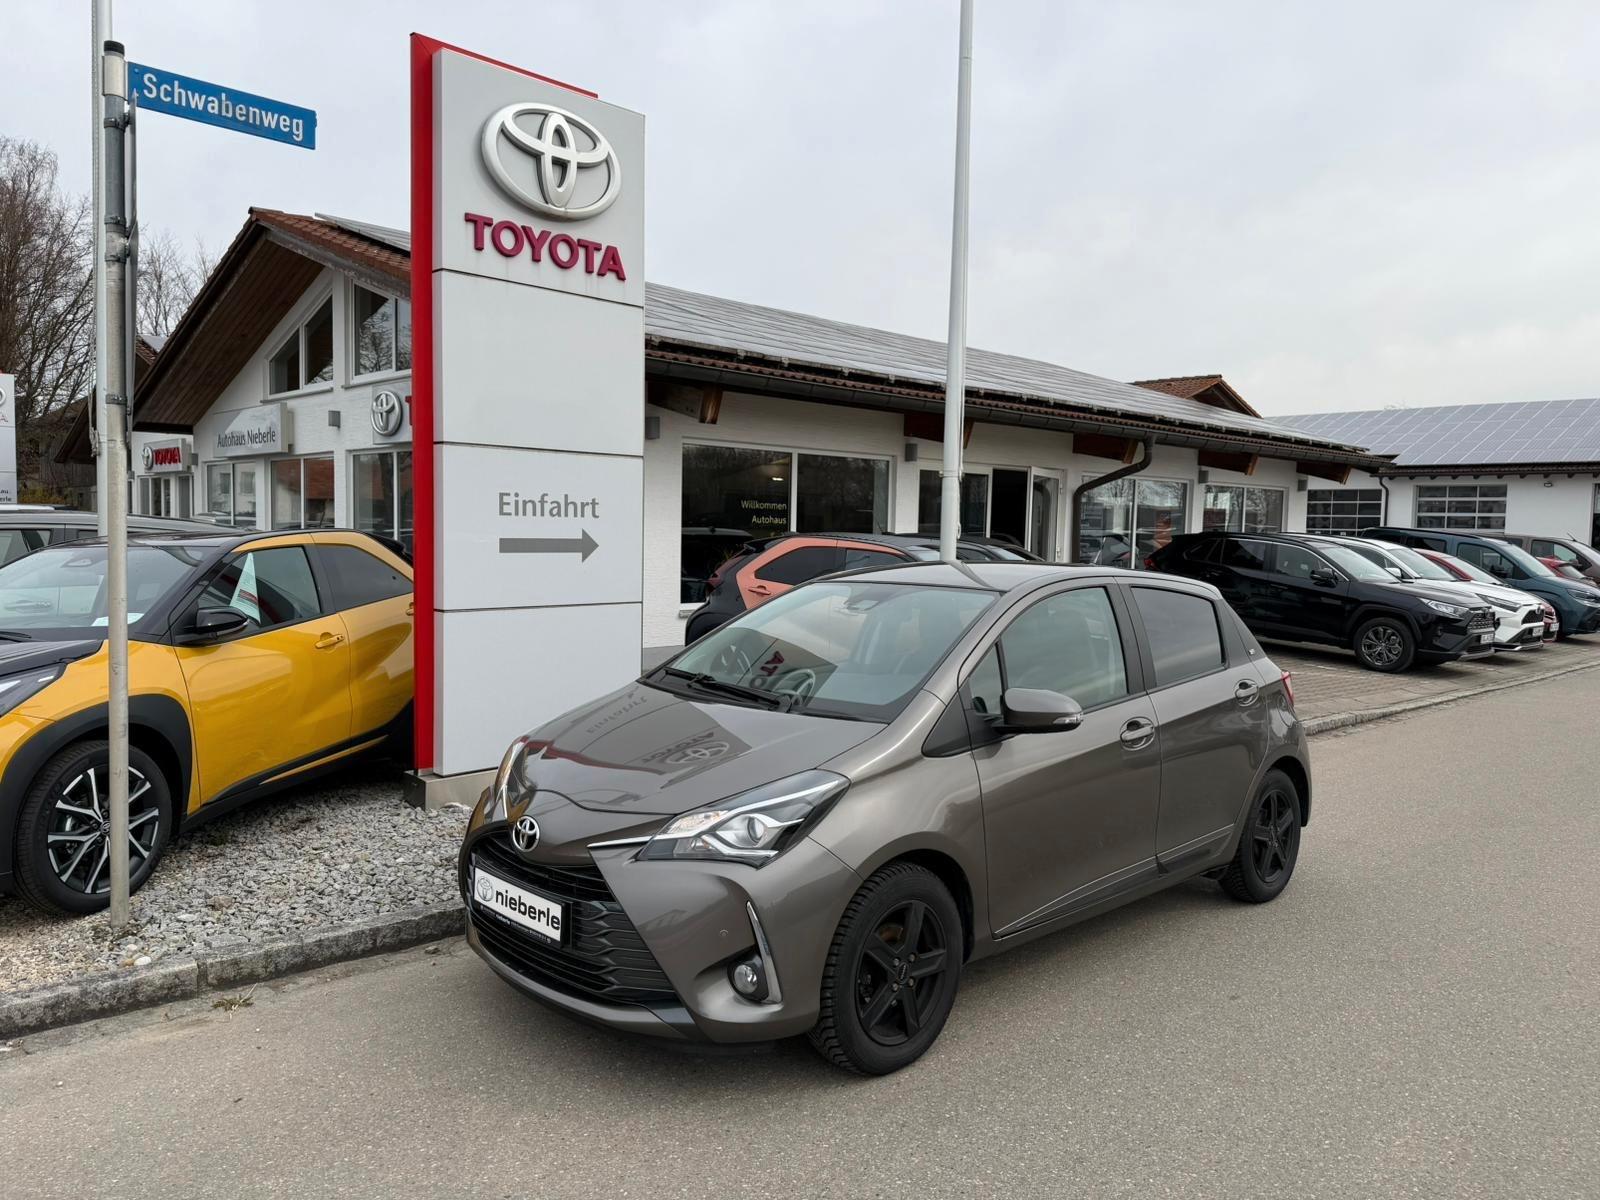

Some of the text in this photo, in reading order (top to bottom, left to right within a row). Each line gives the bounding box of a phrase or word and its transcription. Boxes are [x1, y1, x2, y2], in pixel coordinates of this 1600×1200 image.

[142, 72, 304, 142] Schwabenweg
[464, 212, 627, 281] TOYOTA
[216, 426, 276, 448] Autohaus Nieberle
[498, 491, 600, 519] Einfahrt
[740, 499, 788, 511] Willkommen
[751, 514, 787, 525] Autohaus
[495, 889, 561, 931] nieberle
